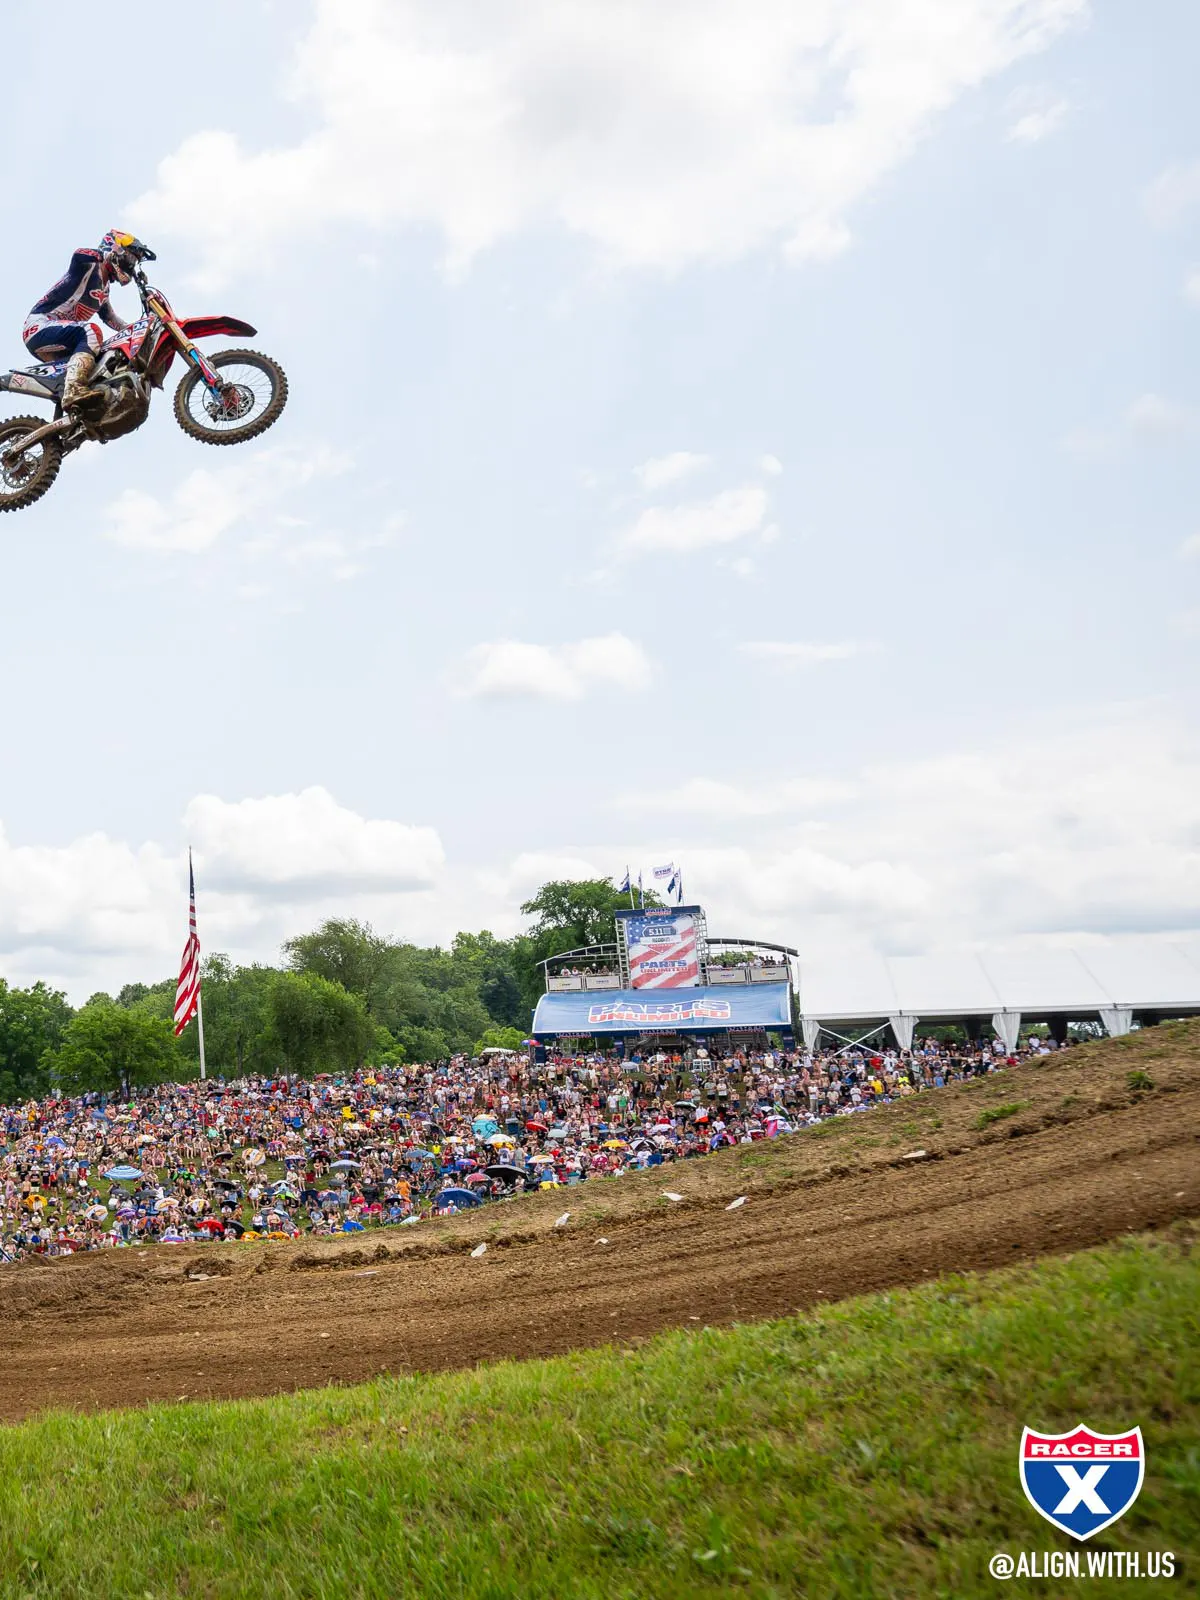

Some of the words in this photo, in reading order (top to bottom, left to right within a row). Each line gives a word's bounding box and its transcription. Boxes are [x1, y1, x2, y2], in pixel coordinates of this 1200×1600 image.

[640, 960, 687, 969] PARTS
[590, 1001, 730, 1015] PARTS
[590, 1009, 729, 1022] UNLIMITED
